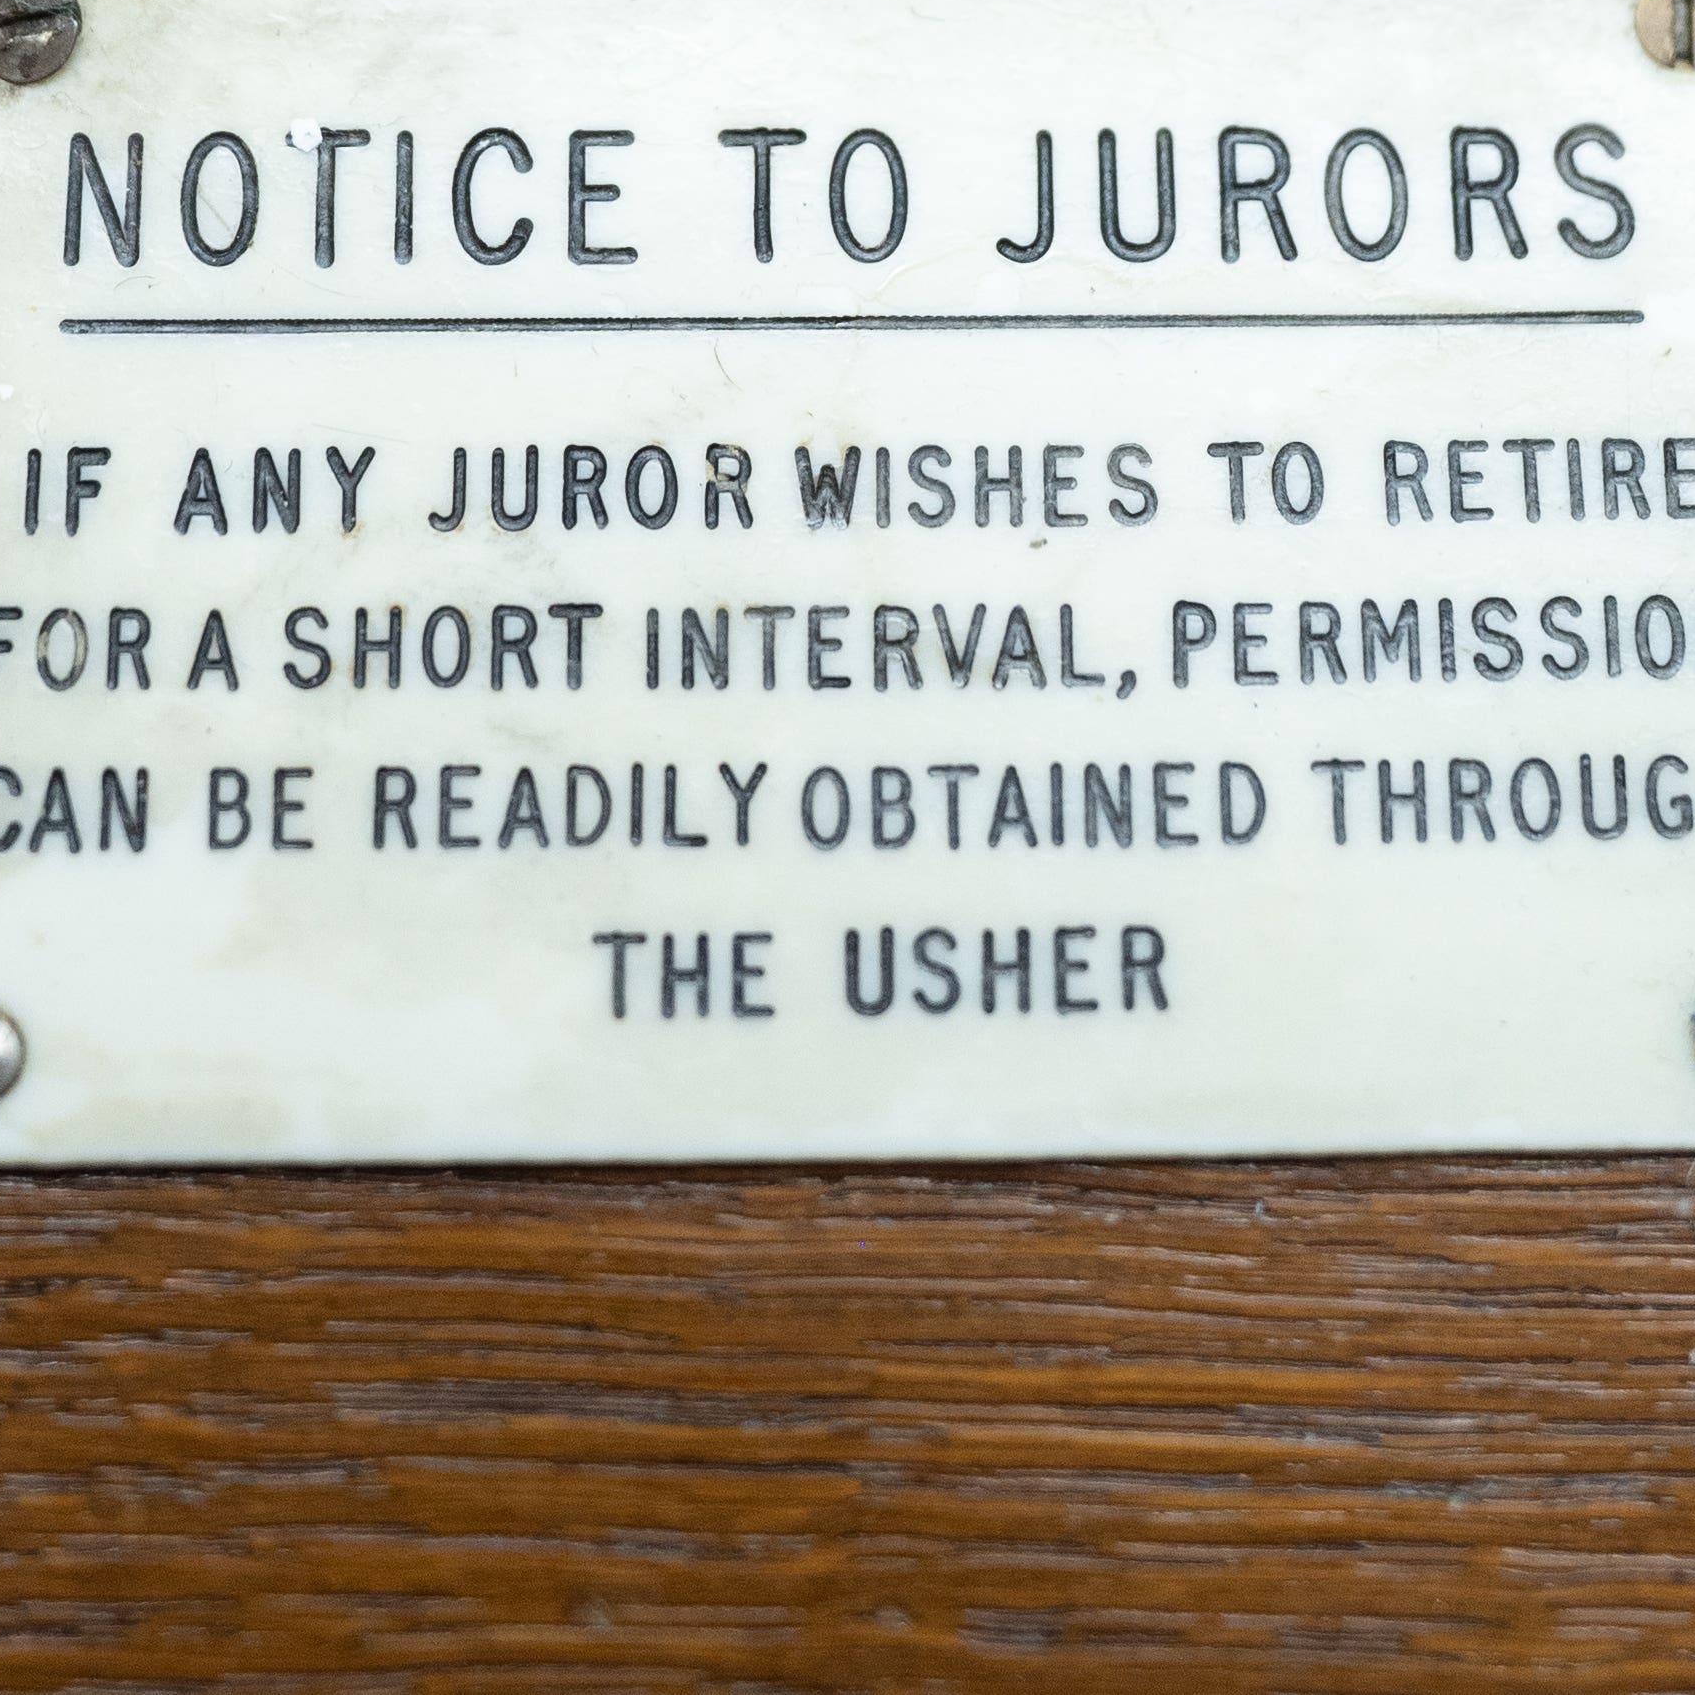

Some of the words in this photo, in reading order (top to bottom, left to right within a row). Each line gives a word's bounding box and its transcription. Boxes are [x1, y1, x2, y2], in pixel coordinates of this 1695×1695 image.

[61, 125, 640, 269] NOTICE
[716, 124, 910, 265] TO
[994, 121, 1637, 265] JURORS
[22, 444, 113, 539] IF
[171, 444, 378, 537] ANY
[426, 442, 755, 534] JUROR
[792, 441, 1160, 532] WISHES
[1205, 439, 1326, 526] TO
[185, 607, 241, 694] A
[281, 601, 606, 694] SHORT
[644, 599, 1139, 701] INTERVAL,
[206, 764, 316, 853] BE
[370, 760, 770, 852] READILY
[799, 759, 1268, 853] OBTAINED
[590, 928, 777, 1021] THE
[842, 923, 1171, 1019] USHER
